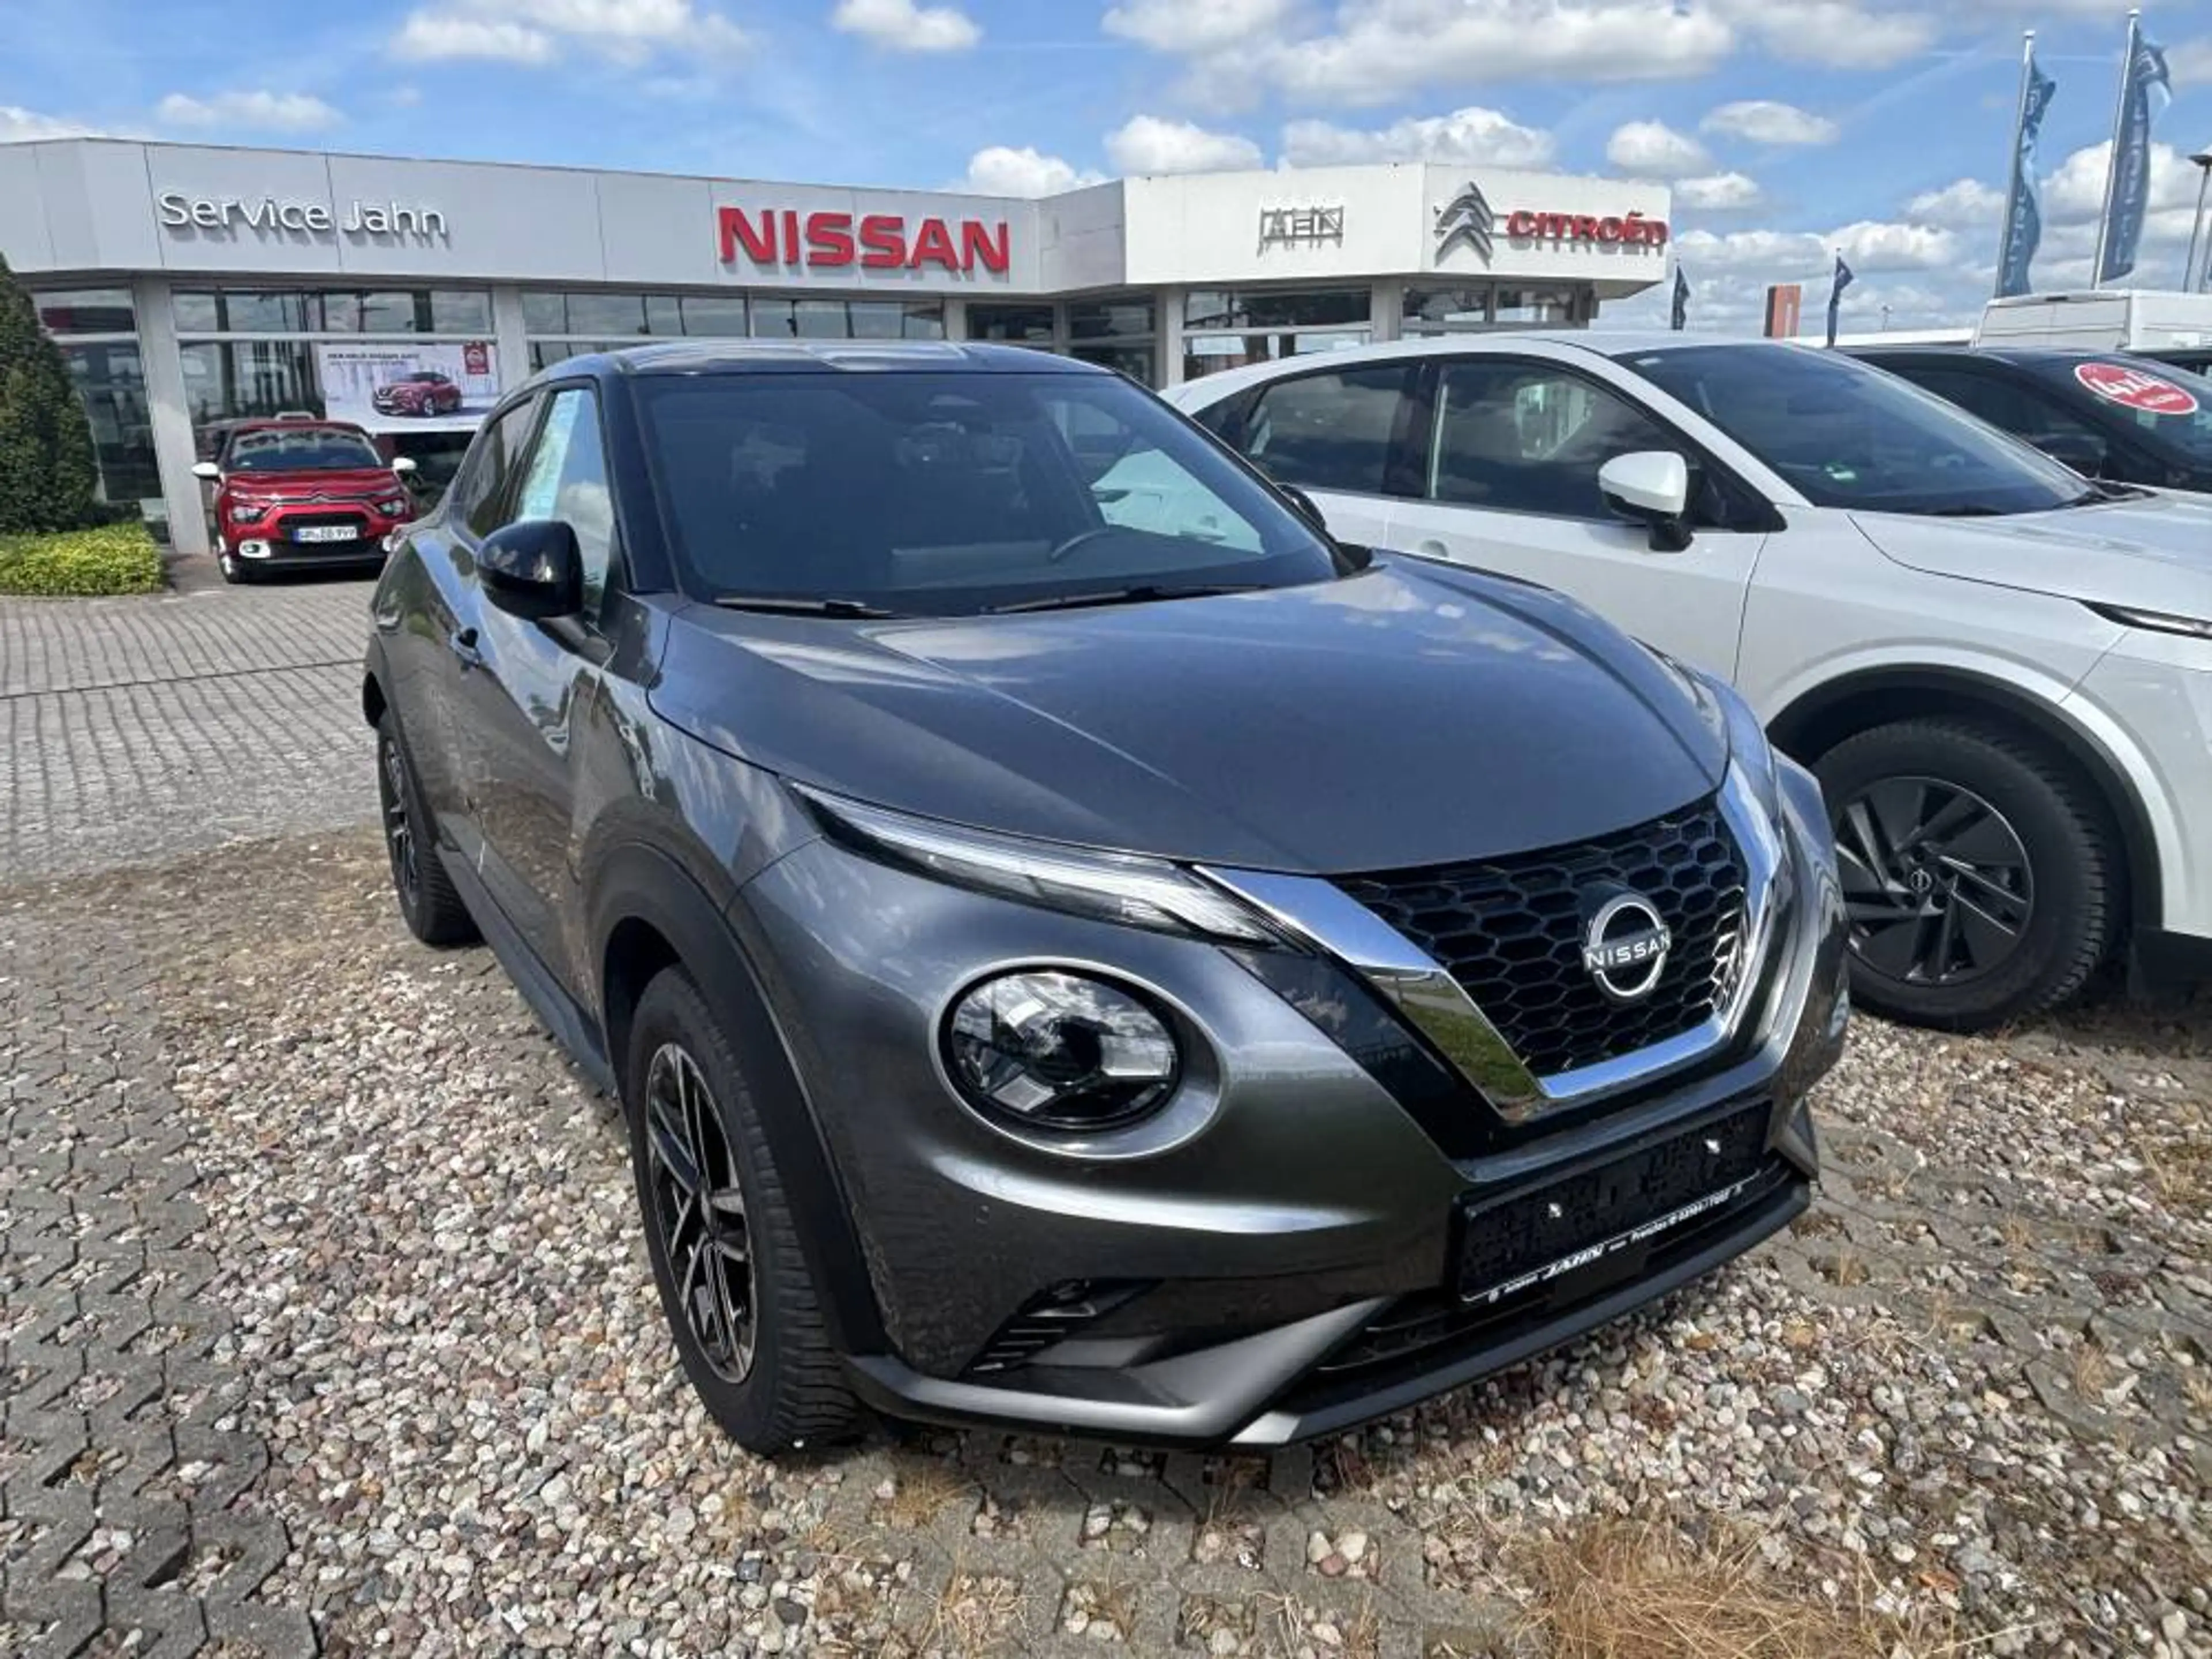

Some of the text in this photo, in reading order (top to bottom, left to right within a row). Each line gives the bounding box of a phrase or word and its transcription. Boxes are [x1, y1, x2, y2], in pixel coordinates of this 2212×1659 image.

[159, 192, 448, 235] Service Jahn
[718, 206, 1010, 275] NISSAN
[1585, 927, 1672, 969] NISSAN
